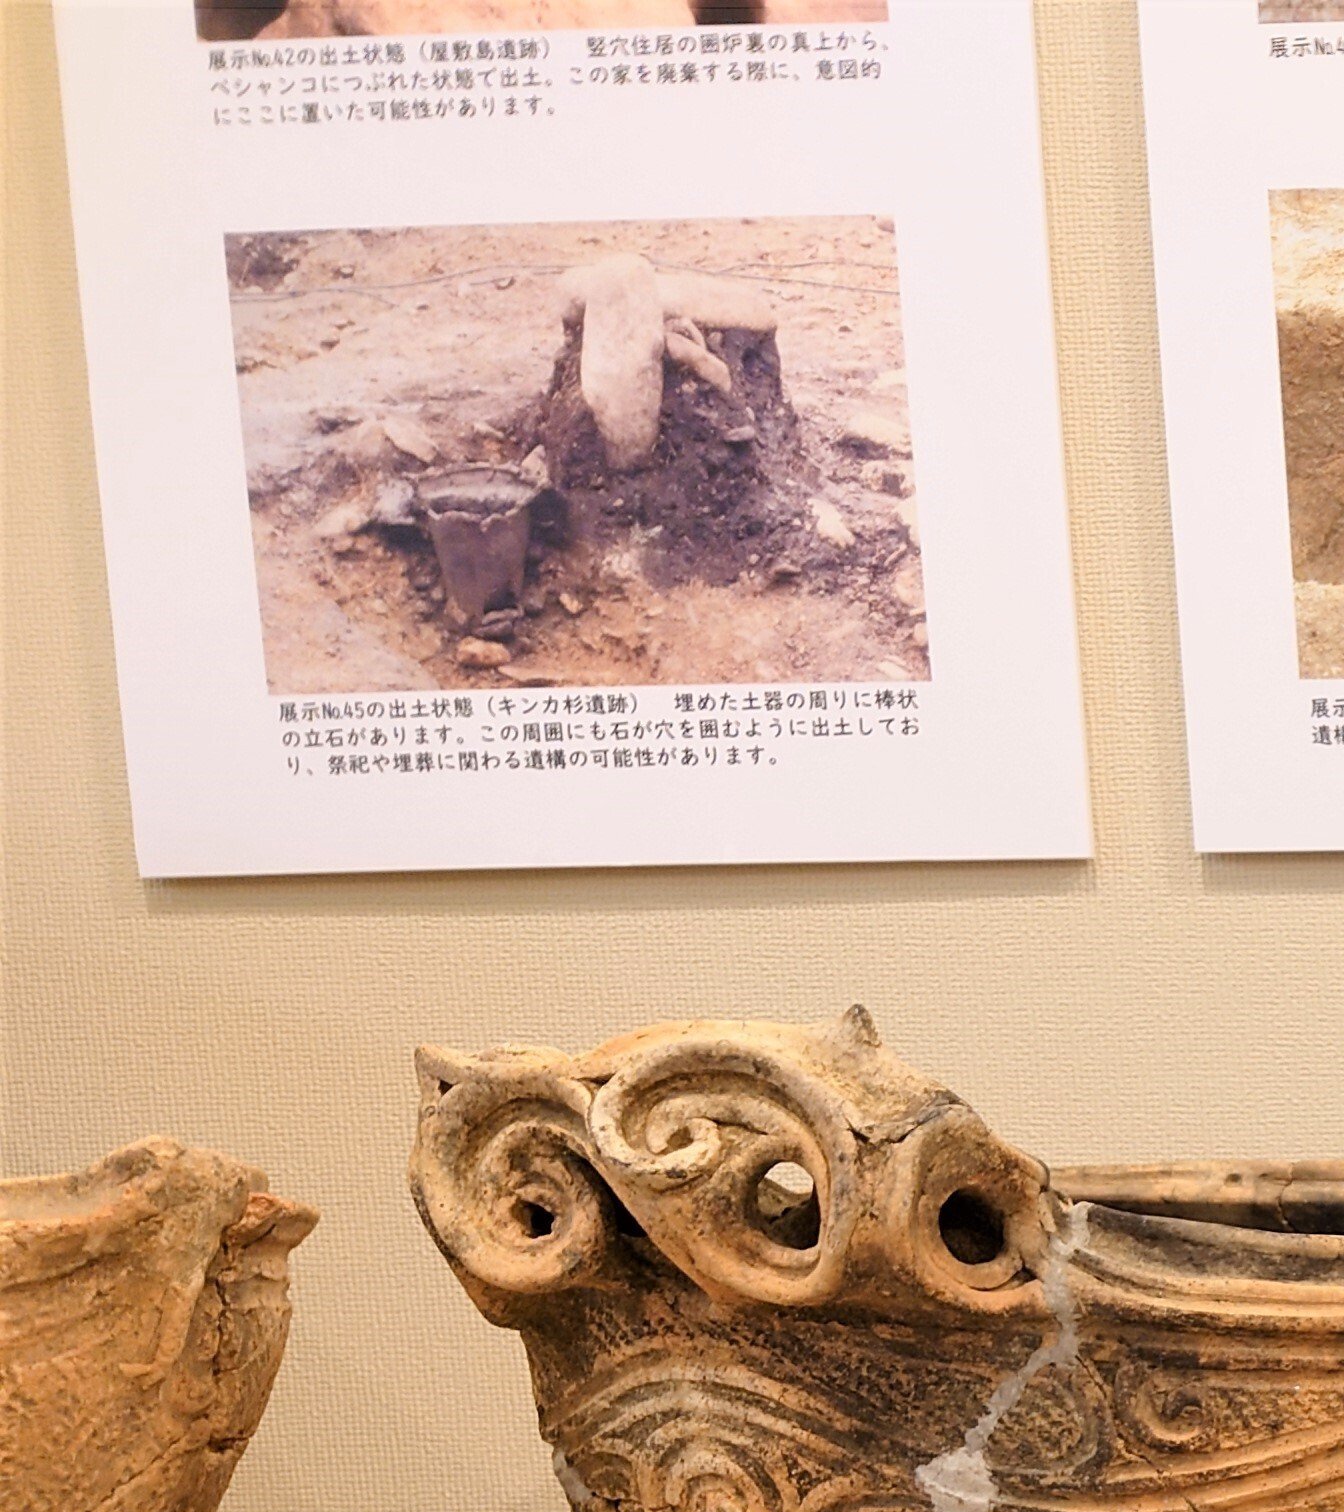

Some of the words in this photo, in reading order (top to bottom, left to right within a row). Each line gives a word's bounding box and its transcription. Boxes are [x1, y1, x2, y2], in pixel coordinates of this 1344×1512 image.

[213, 96, 555, 125] にここに置いた可能性があります。
[673, 688, 919, 713] 埋めた土器の周りに棒状
